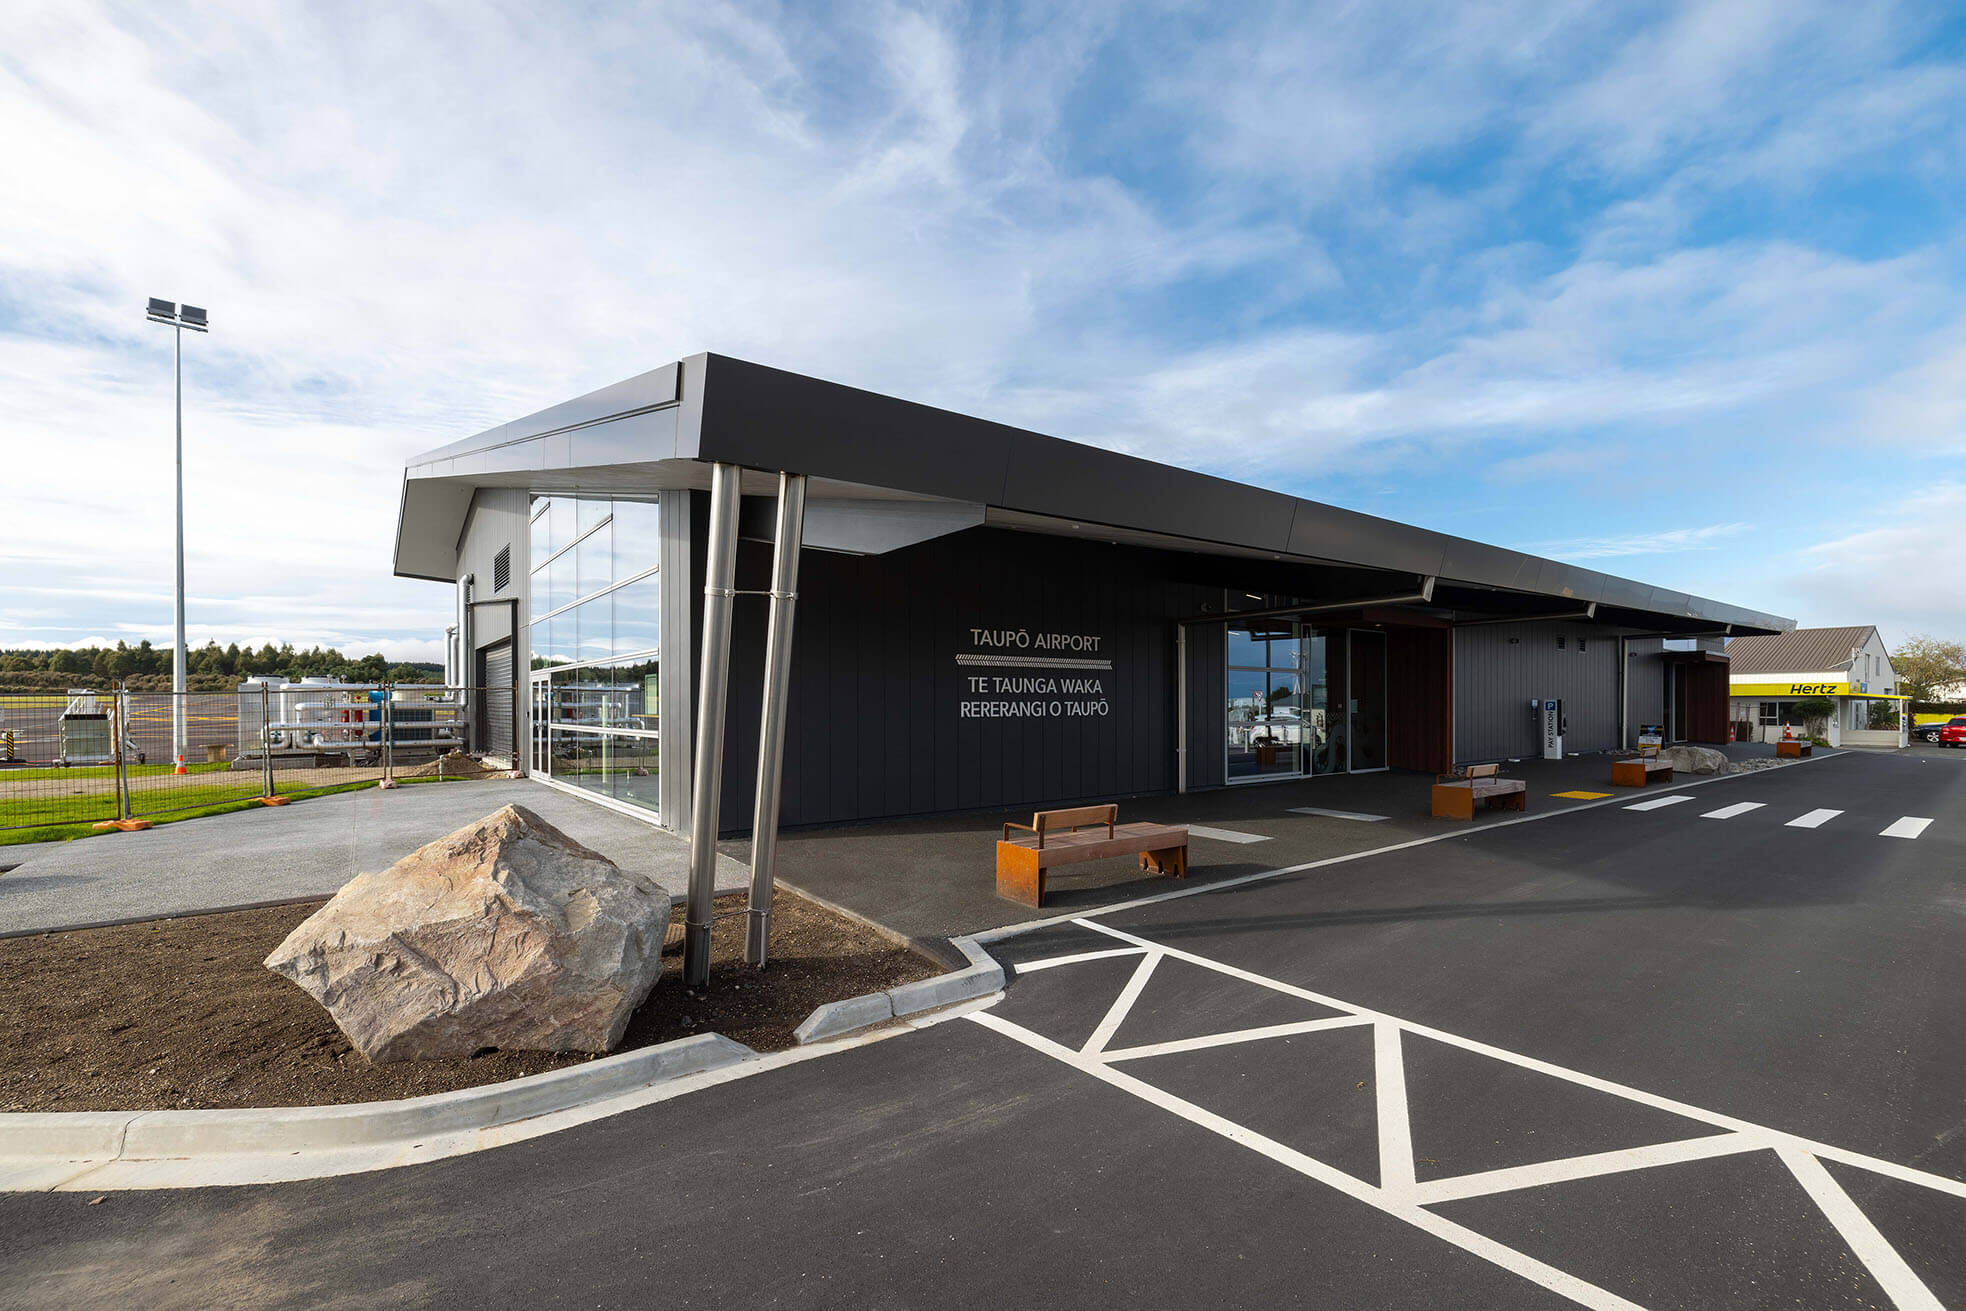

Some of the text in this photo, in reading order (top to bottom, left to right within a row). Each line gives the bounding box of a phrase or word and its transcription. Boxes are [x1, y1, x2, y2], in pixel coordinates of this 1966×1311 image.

[970, 629, 1101, 652] TAUPŌ AIRPORT
[967, 677, 1103, 694] TE TAUNGA WAKA
[1790, 684, 1837, 694] Hertz
[960, 698, 1109, 718] RERERANGI O TAUPŌ
